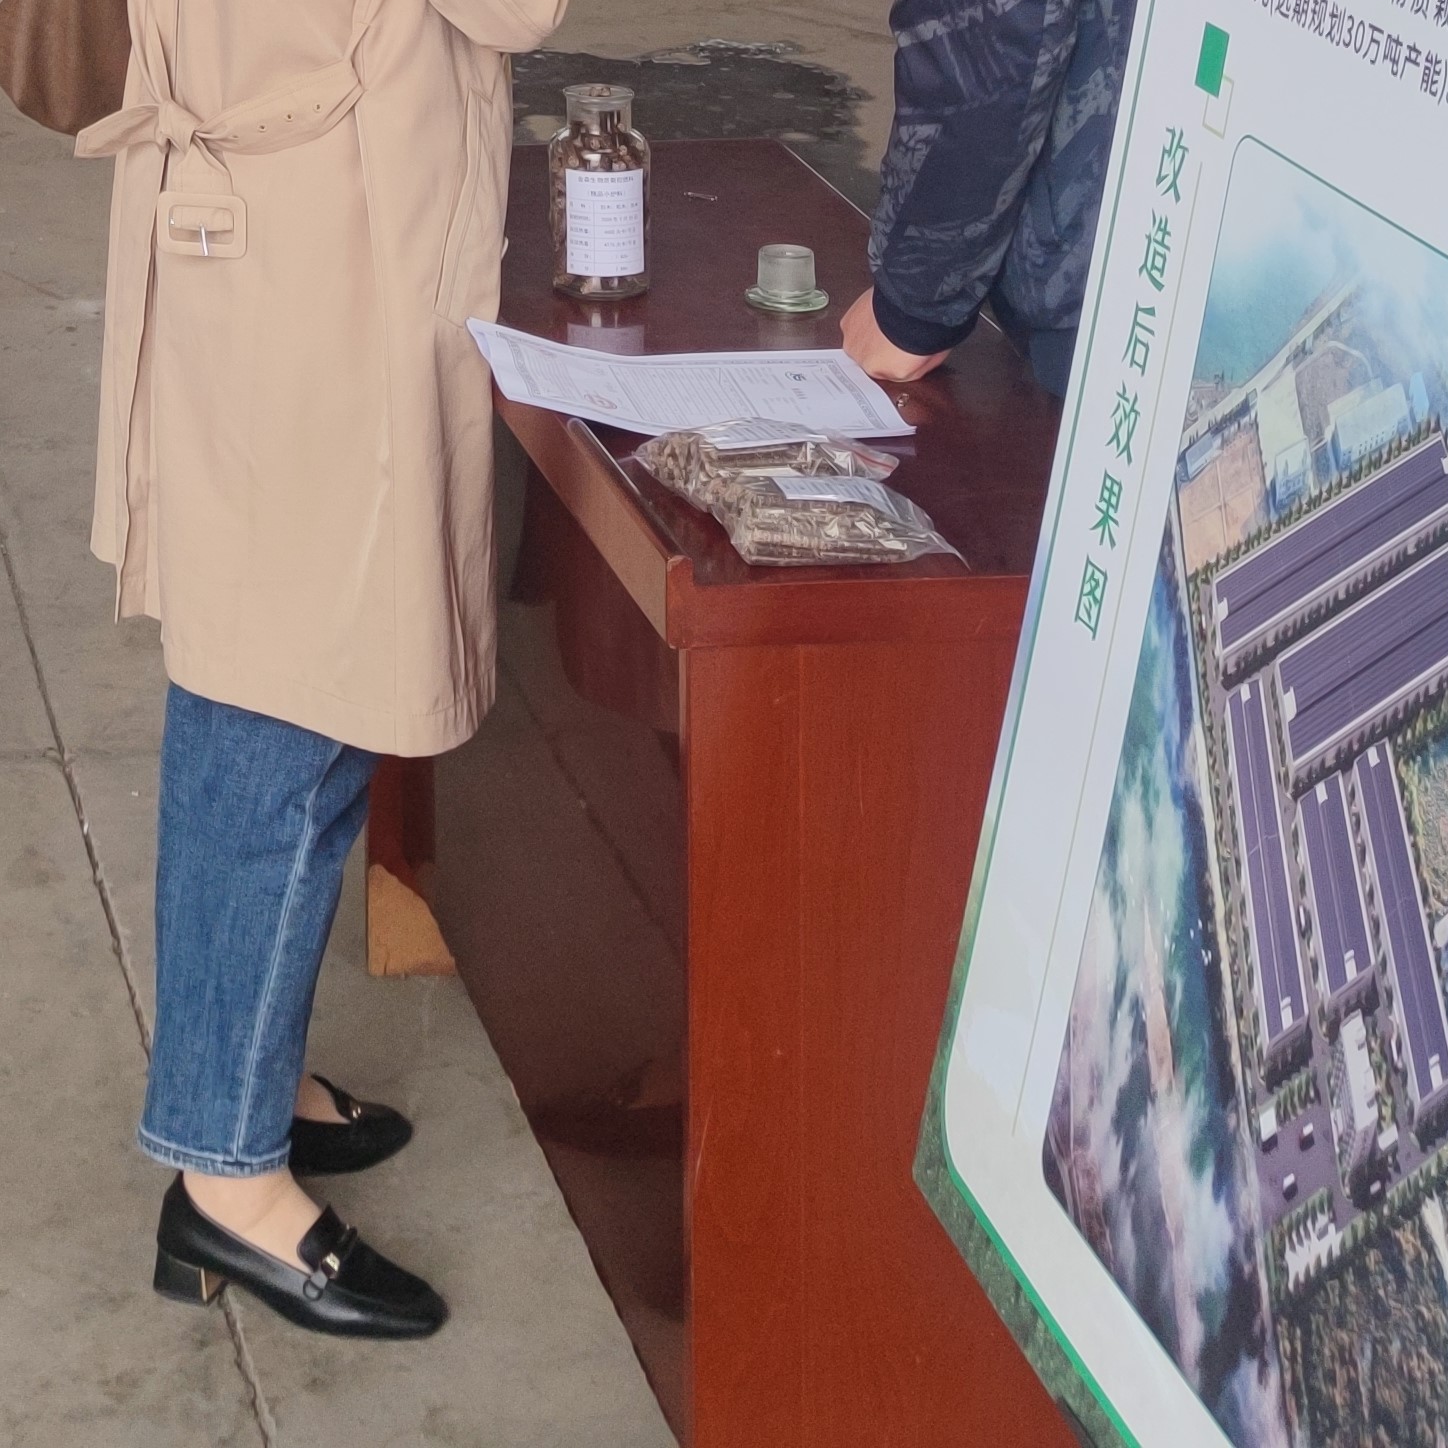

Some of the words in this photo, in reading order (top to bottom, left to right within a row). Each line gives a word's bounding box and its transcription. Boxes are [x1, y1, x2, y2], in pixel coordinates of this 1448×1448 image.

[1072, 125, 1189, 641] 改造后效果图
